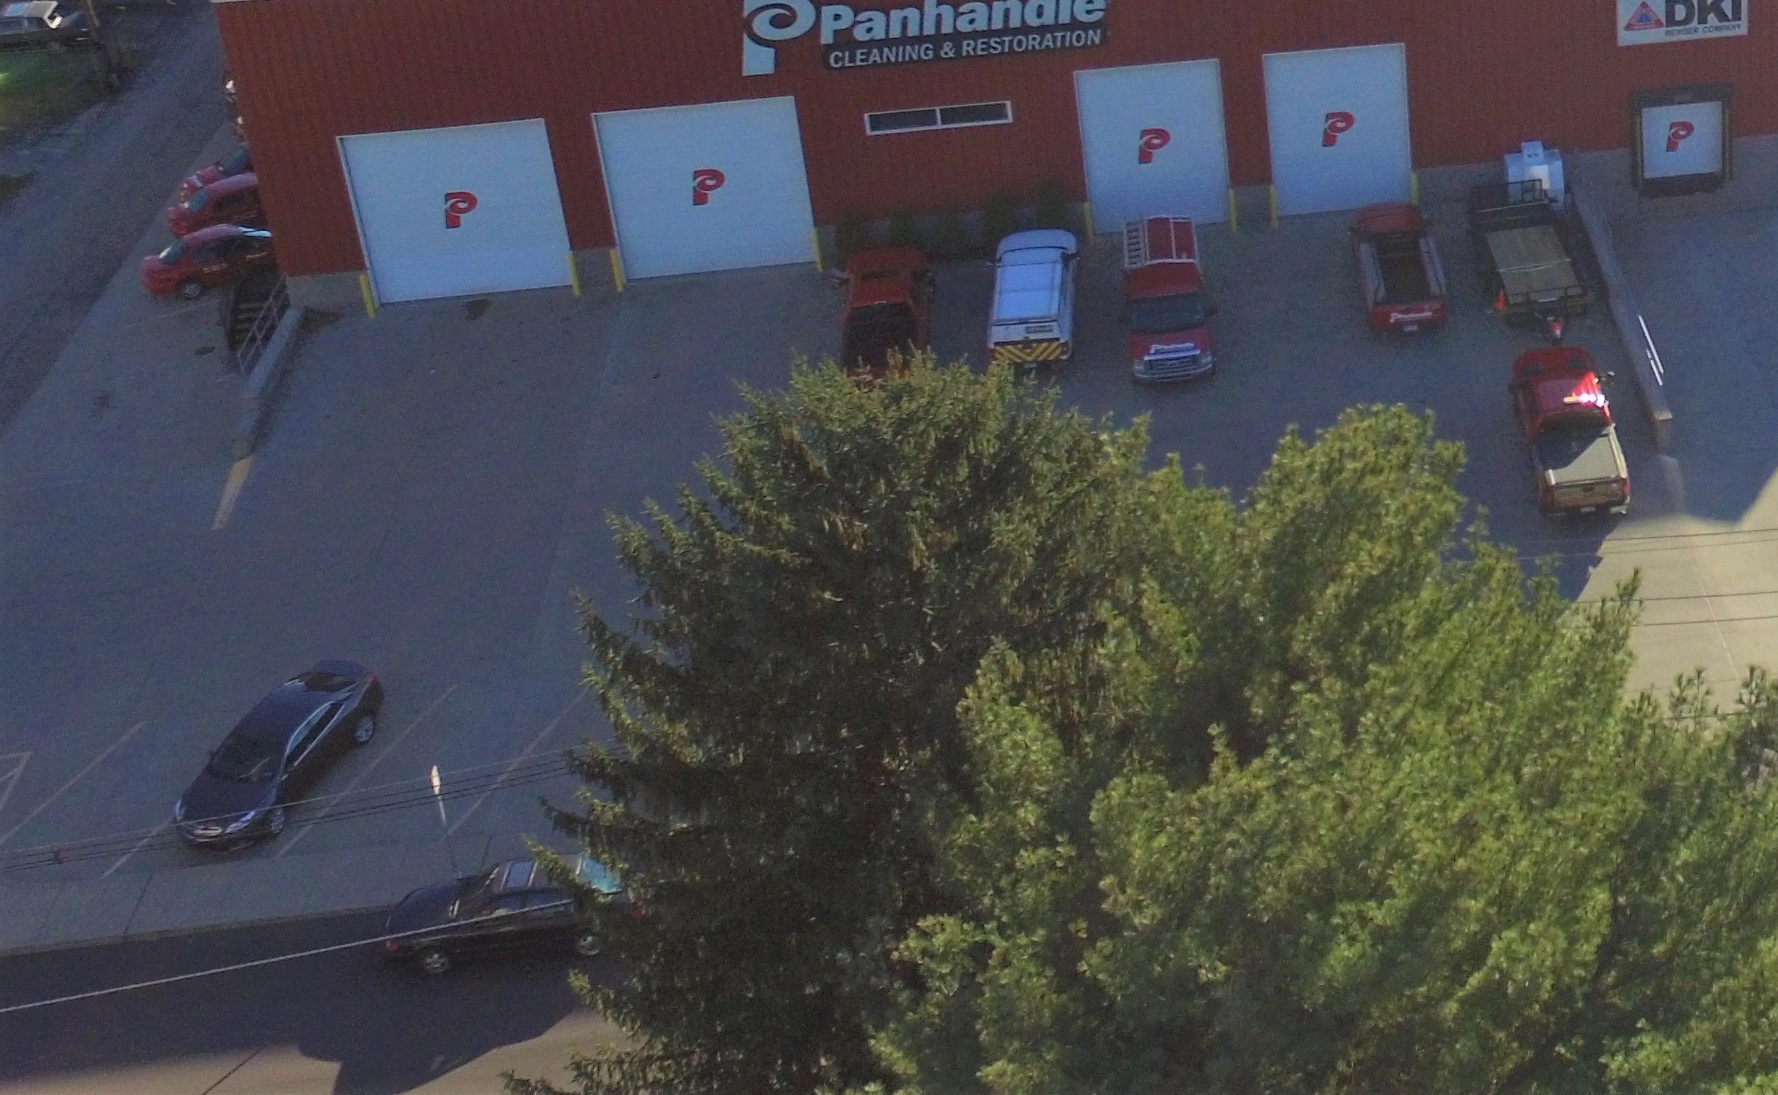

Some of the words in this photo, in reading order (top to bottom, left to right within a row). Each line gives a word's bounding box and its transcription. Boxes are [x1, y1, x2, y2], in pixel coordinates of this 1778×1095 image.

[828, 42, 935, 69] CLEANING
[940, 40, 956, 59] &
[961, 28, 1103, 57] RESTORATION
